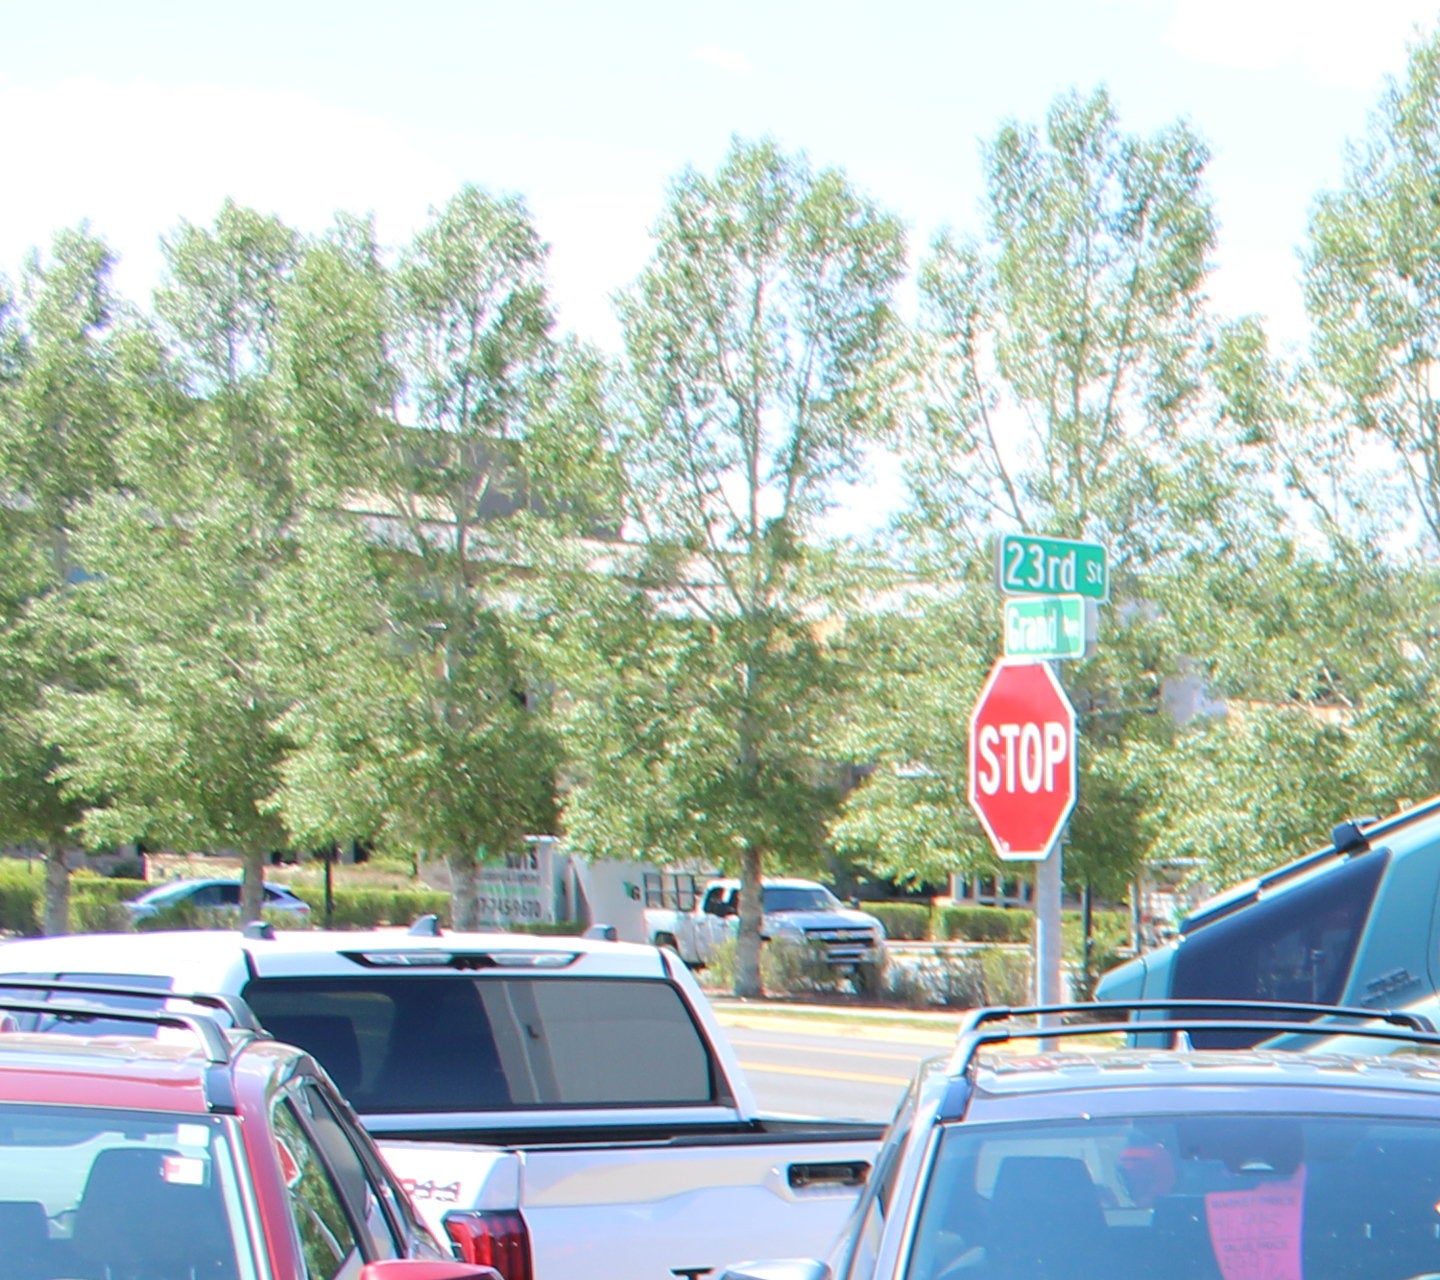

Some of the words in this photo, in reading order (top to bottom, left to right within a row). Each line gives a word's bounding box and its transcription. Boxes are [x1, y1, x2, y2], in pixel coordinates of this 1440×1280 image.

[1005, 540, 1076, 593] 23rd
[1006, 606, 1057, 651] Grand
[978, 721, 1068, 796] STOP
